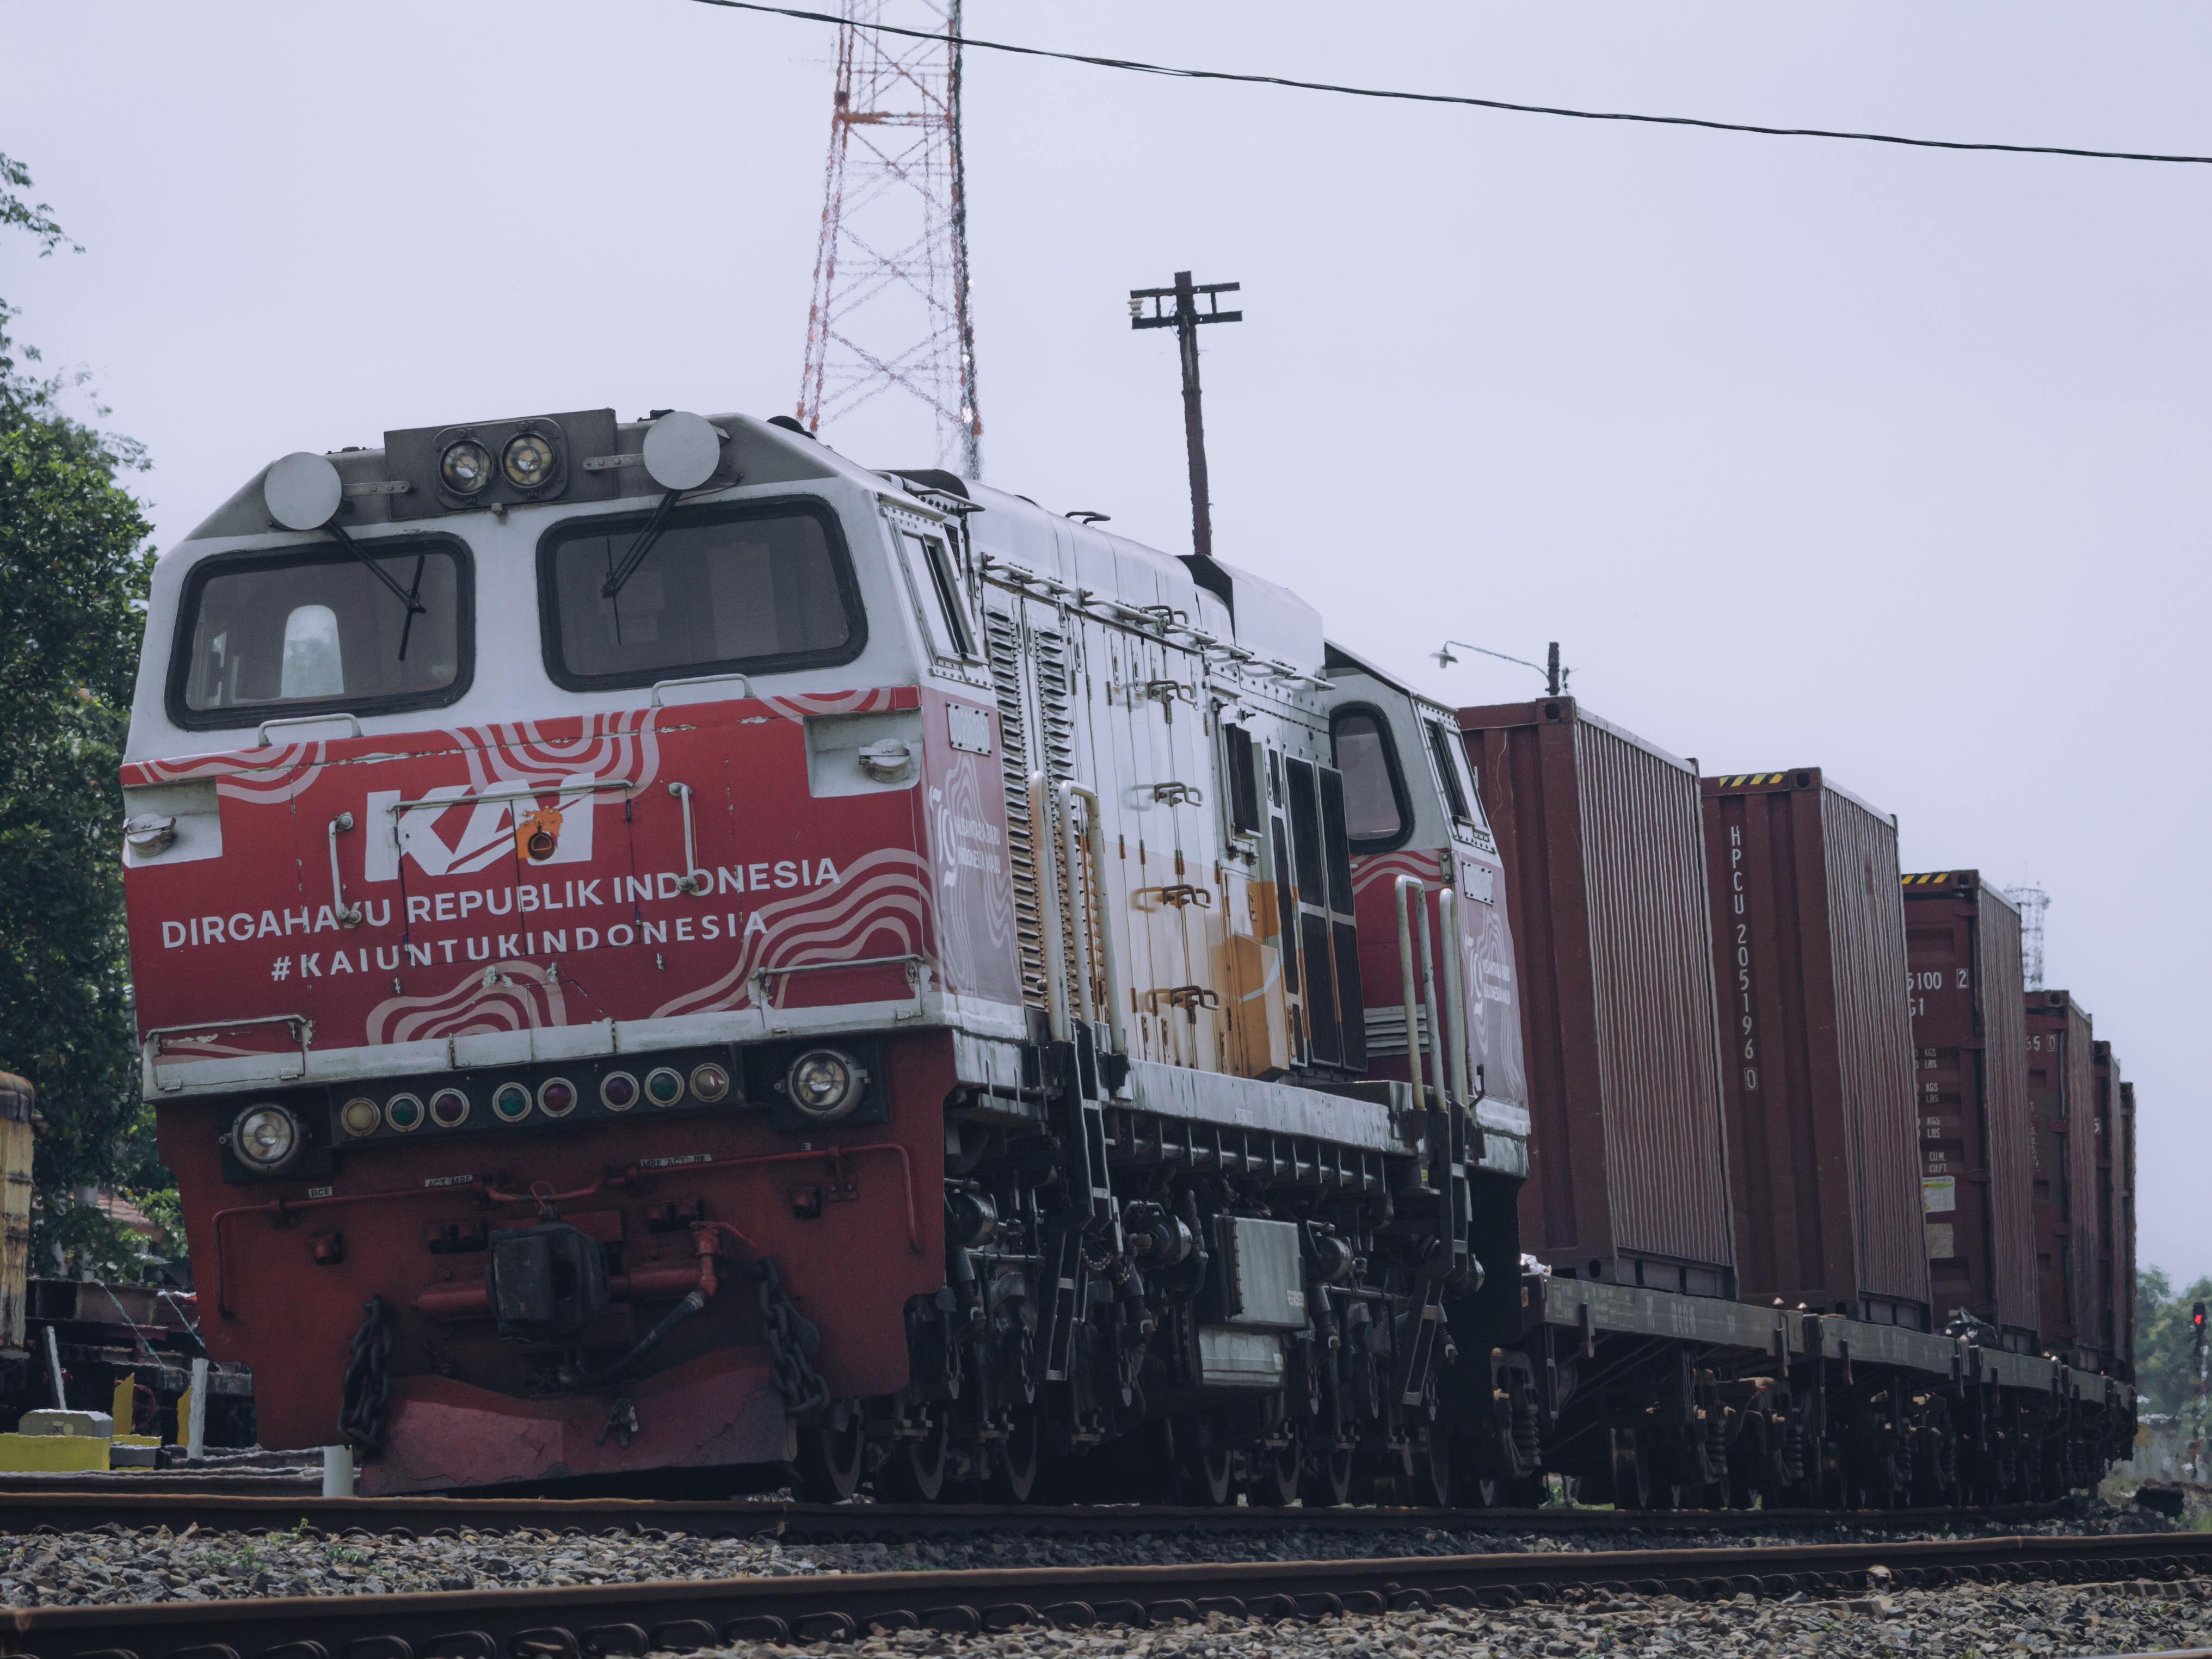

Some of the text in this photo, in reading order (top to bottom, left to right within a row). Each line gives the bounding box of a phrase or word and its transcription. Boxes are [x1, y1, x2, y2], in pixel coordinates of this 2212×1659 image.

[950, 708, 961, 742] CC
[956, 816, 1001, 846] NUSANTARA BARU
[958, 847, 1001, 874] INDONESIA MAJU
[1730, 825, 1745, 915] HPCU
[407, 879, 603, 923] REPUBLIK
[614, 858, 841, 904] INDONESIA
[272, 911, 768, 981] #KAIUNTUKINDONESIA
[1736, 924, 1754, 1060] 205196
[1925, 1048, 1937, 1057] KGS
[1925, 1059, 1937, 1069] LBS
[1926, 1083, 1938, 1092] KGS
[1926, 1094, 1939, 1103] LBS
[1927, 1117, 1940, 1125] KGS
[1927, 1128, 1940, 1138] LBS
[643, 1158, 662, 1168] MRE
[667, 1156, 686, 1166] ACT
[429, 1179, 446, 1187] ACT
[311, 1188, 330, 1197] BCE
